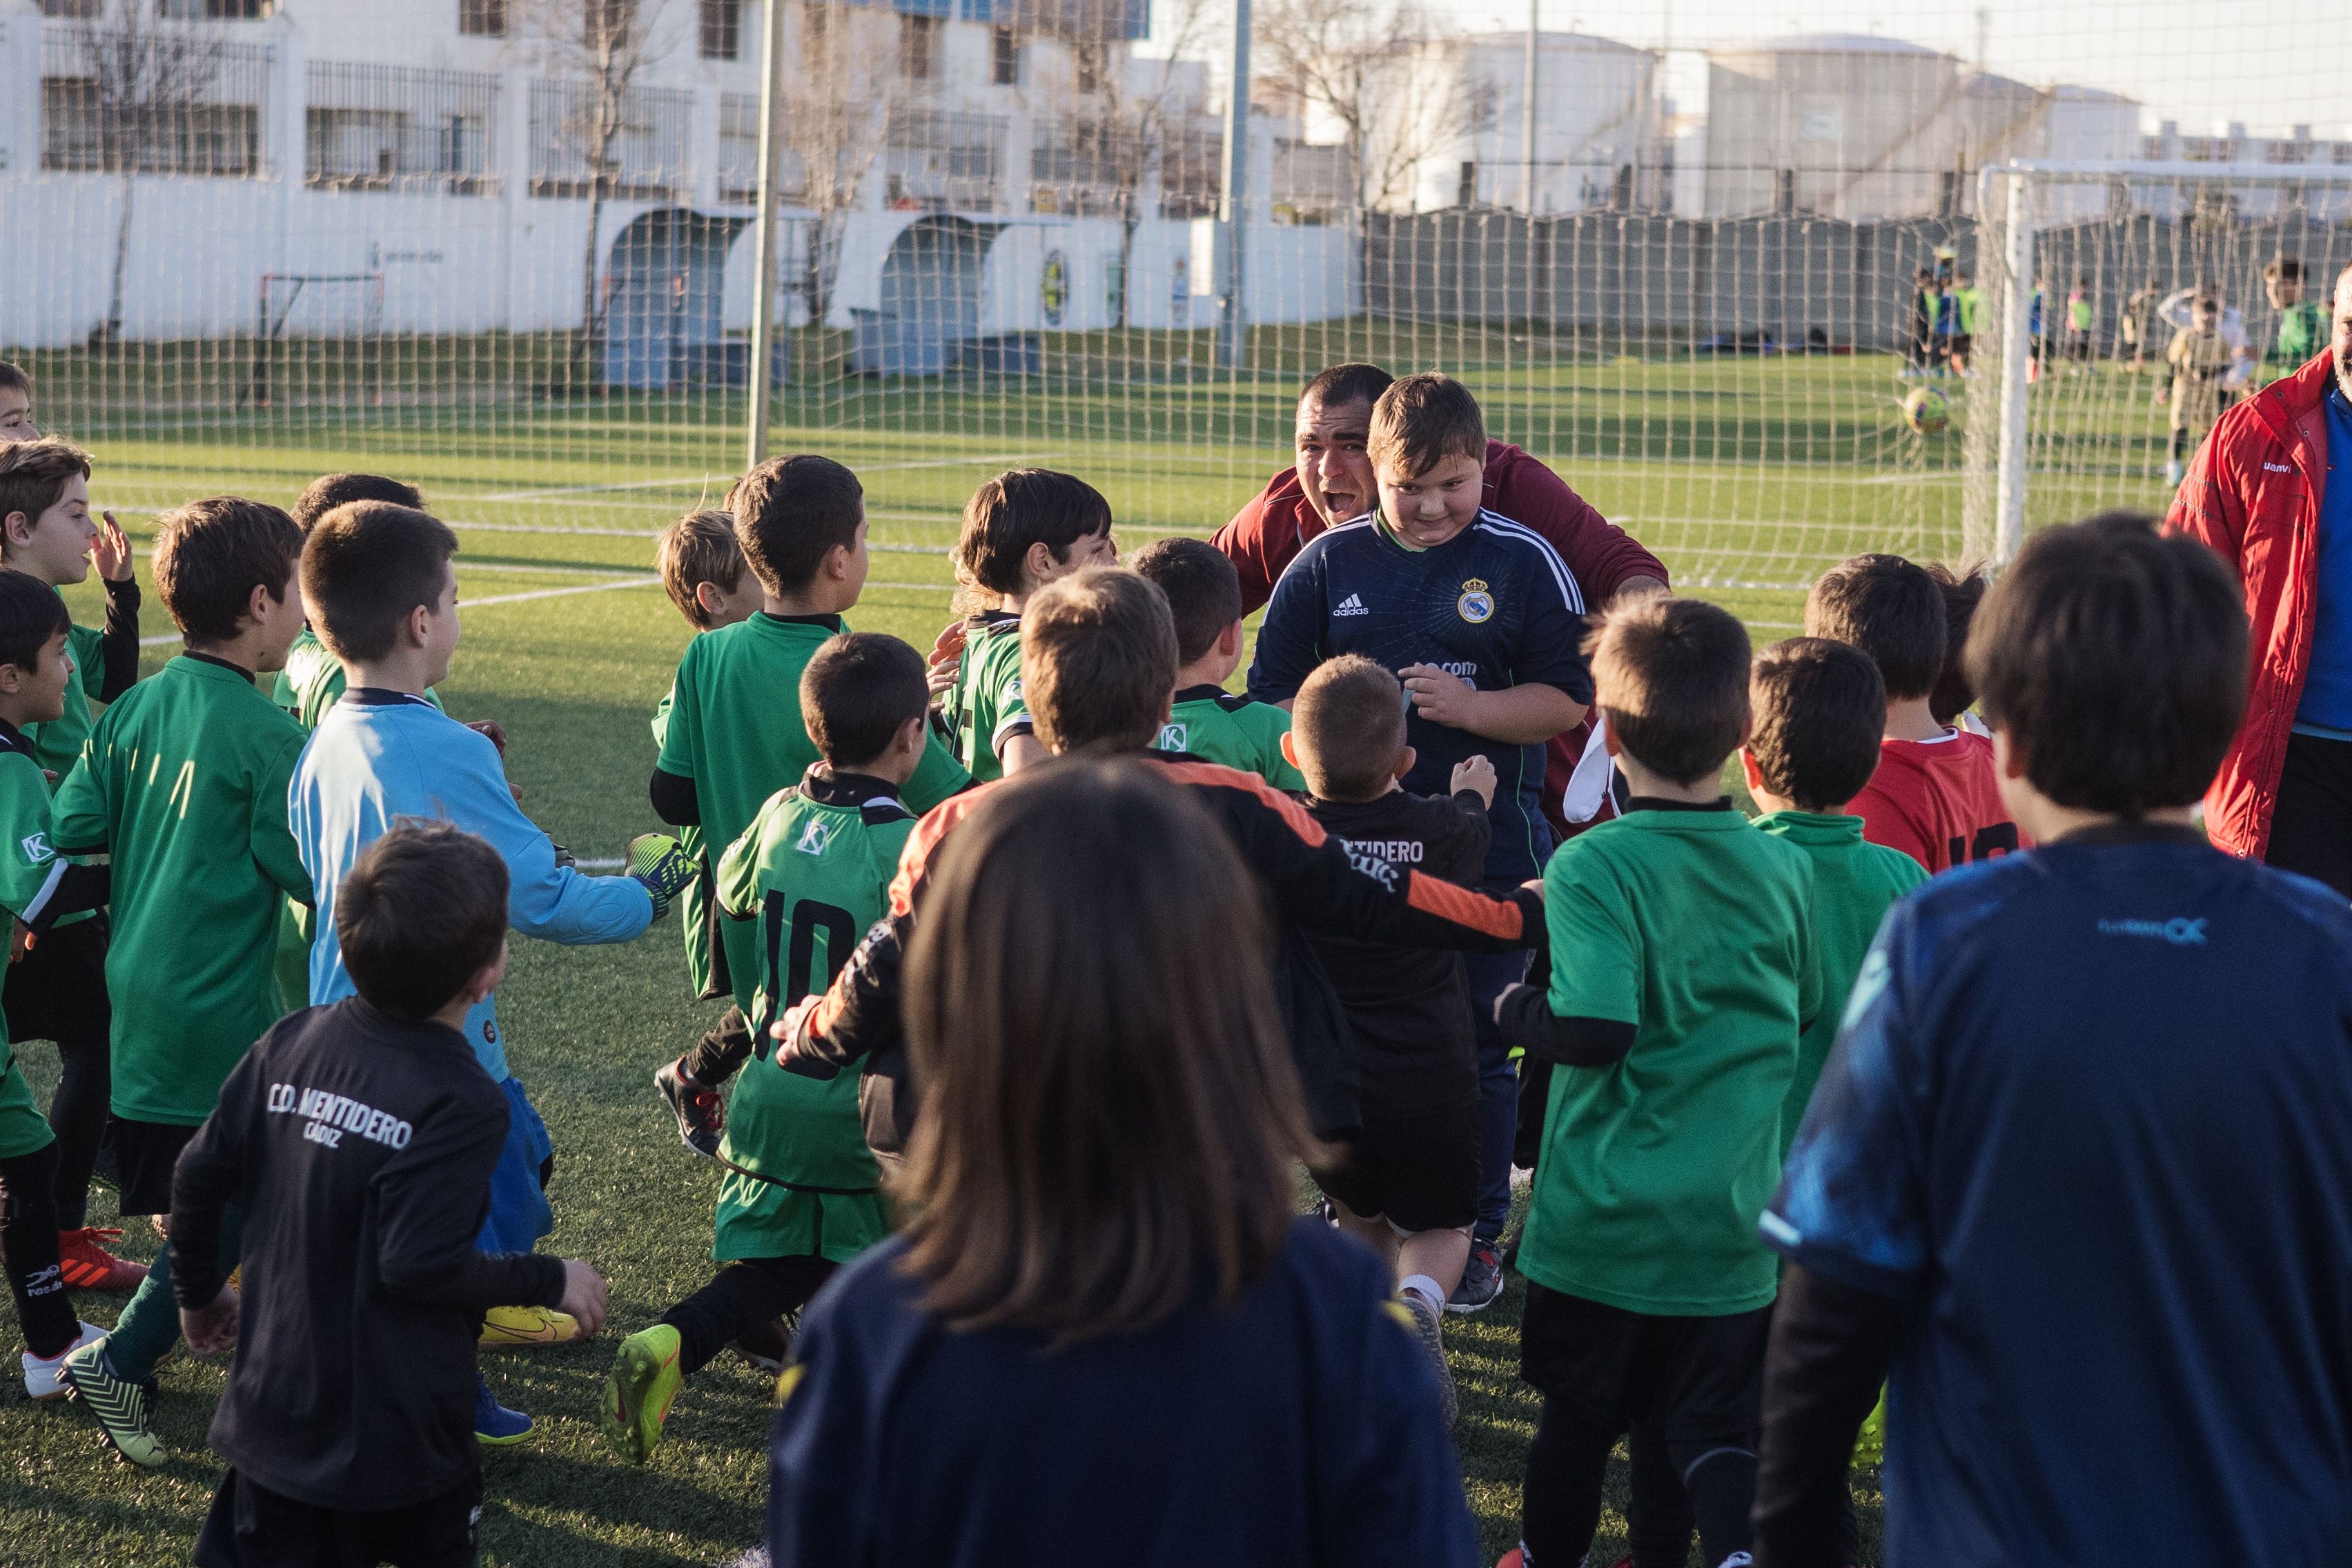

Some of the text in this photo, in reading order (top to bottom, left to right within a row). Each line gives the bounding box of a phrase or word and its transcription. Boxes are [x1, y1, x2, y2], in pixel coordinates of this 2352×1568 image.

[1333, 606, 1369, 616] adidas
[1349, 841, 1423, 862] TIDERO
[297, 1087, 413, 1150] MENTIDERO
